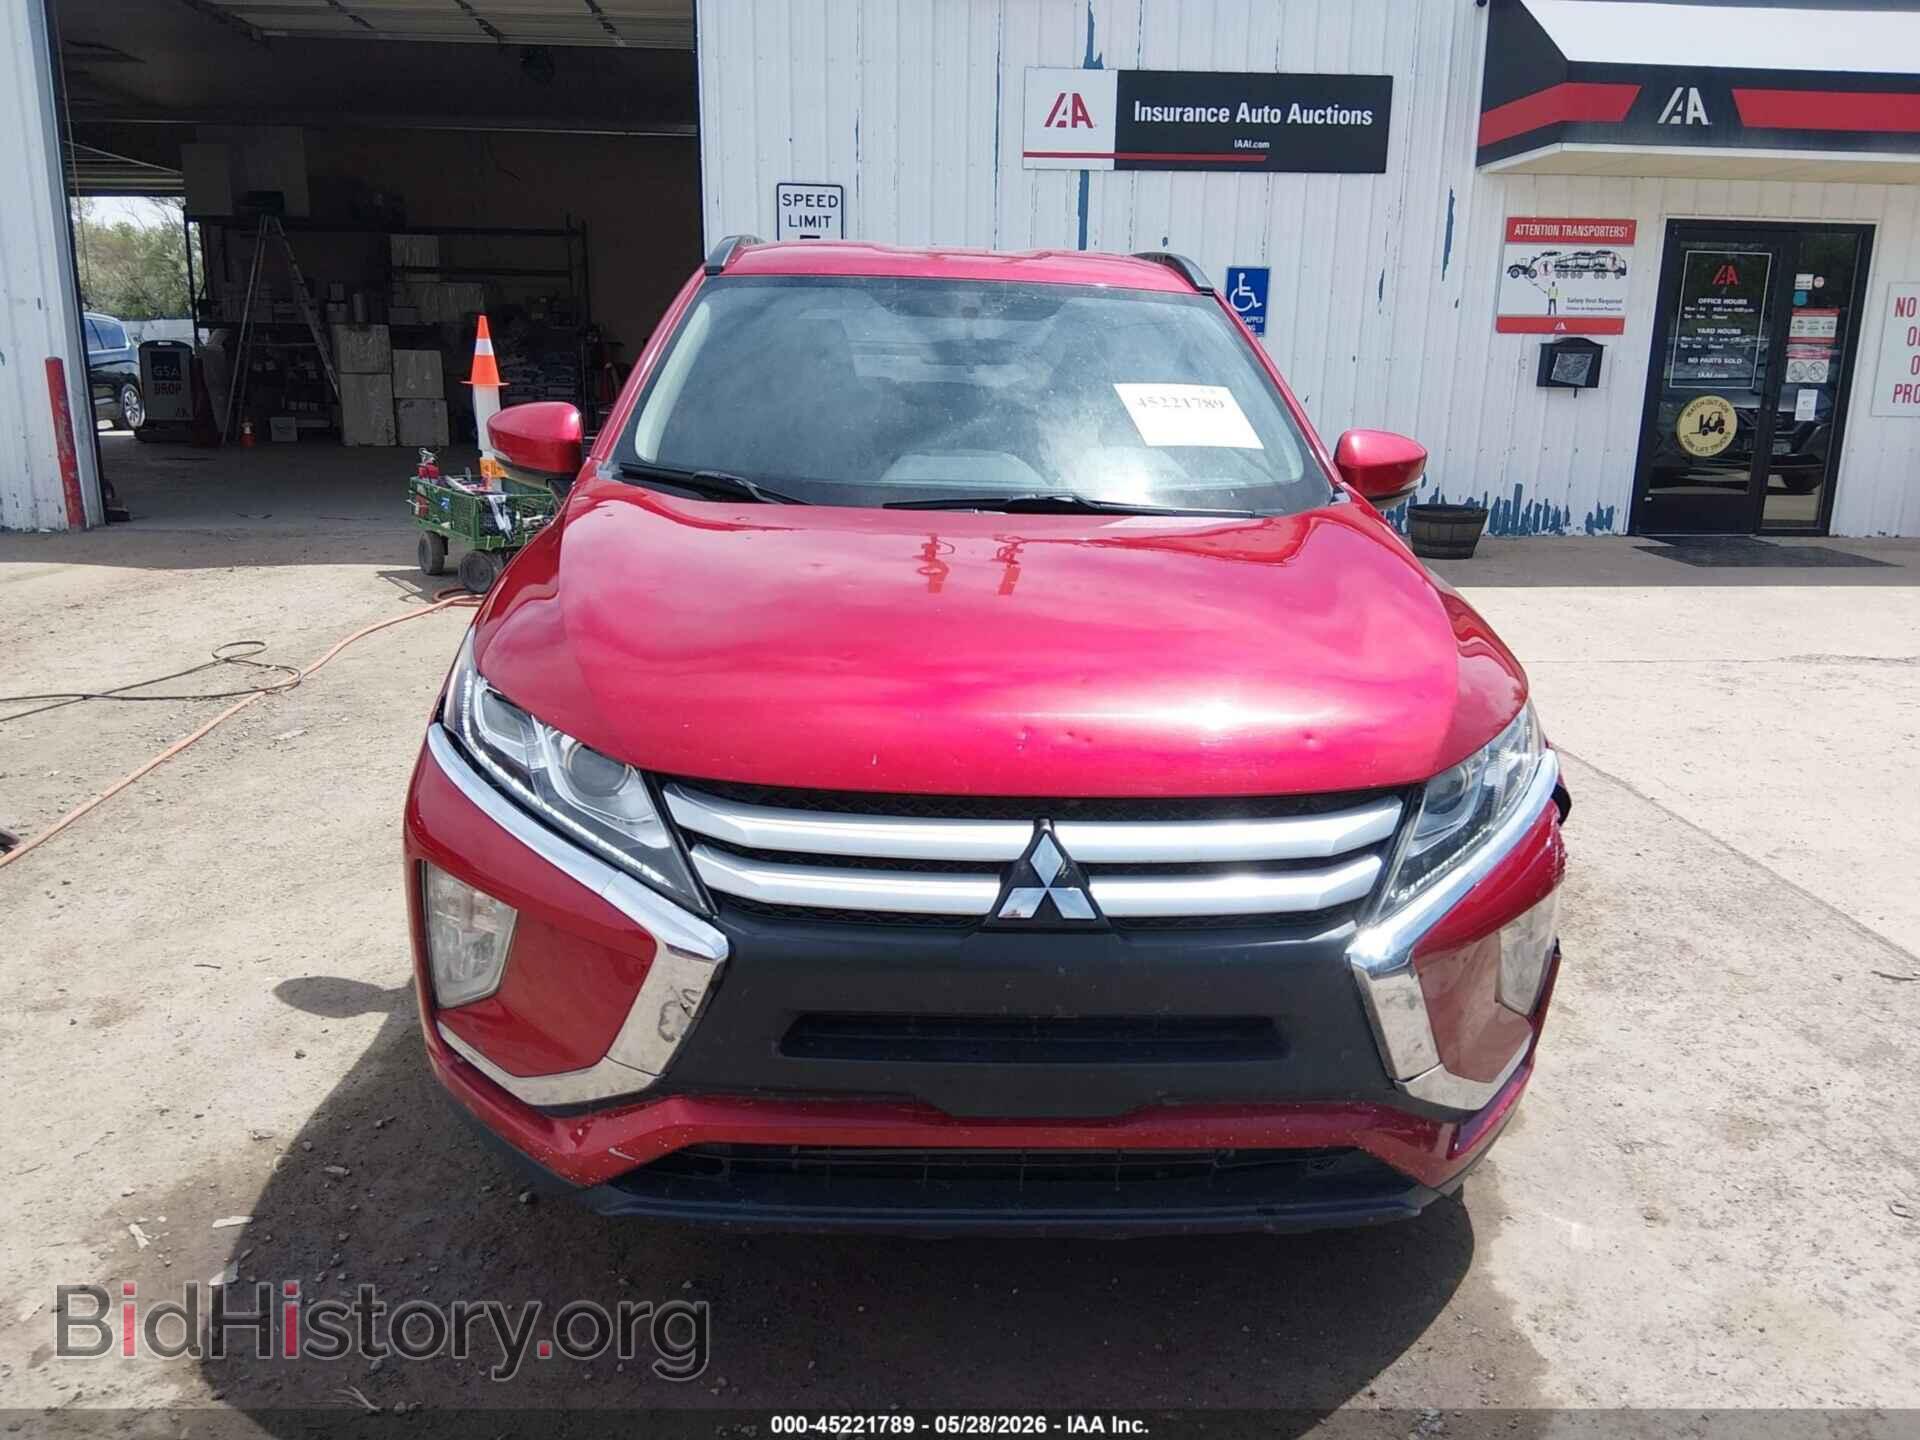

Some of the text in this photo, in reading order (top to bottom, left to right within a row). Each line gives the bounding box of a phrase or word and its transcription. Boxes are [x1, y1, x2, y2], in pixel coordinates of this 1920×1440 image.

[1133, 100, 1373, 126] Insurance Auto Auctions
[1233, 138, 1271, 150] IAAI.com
[782, 193, 839, 208] SPEED
[788, 214, 832, 229] LIMIT
[1513, 223, 1628, 238] ATTENTION TRANSPORTERS!
[1895, 297, 1917, 318] NO
